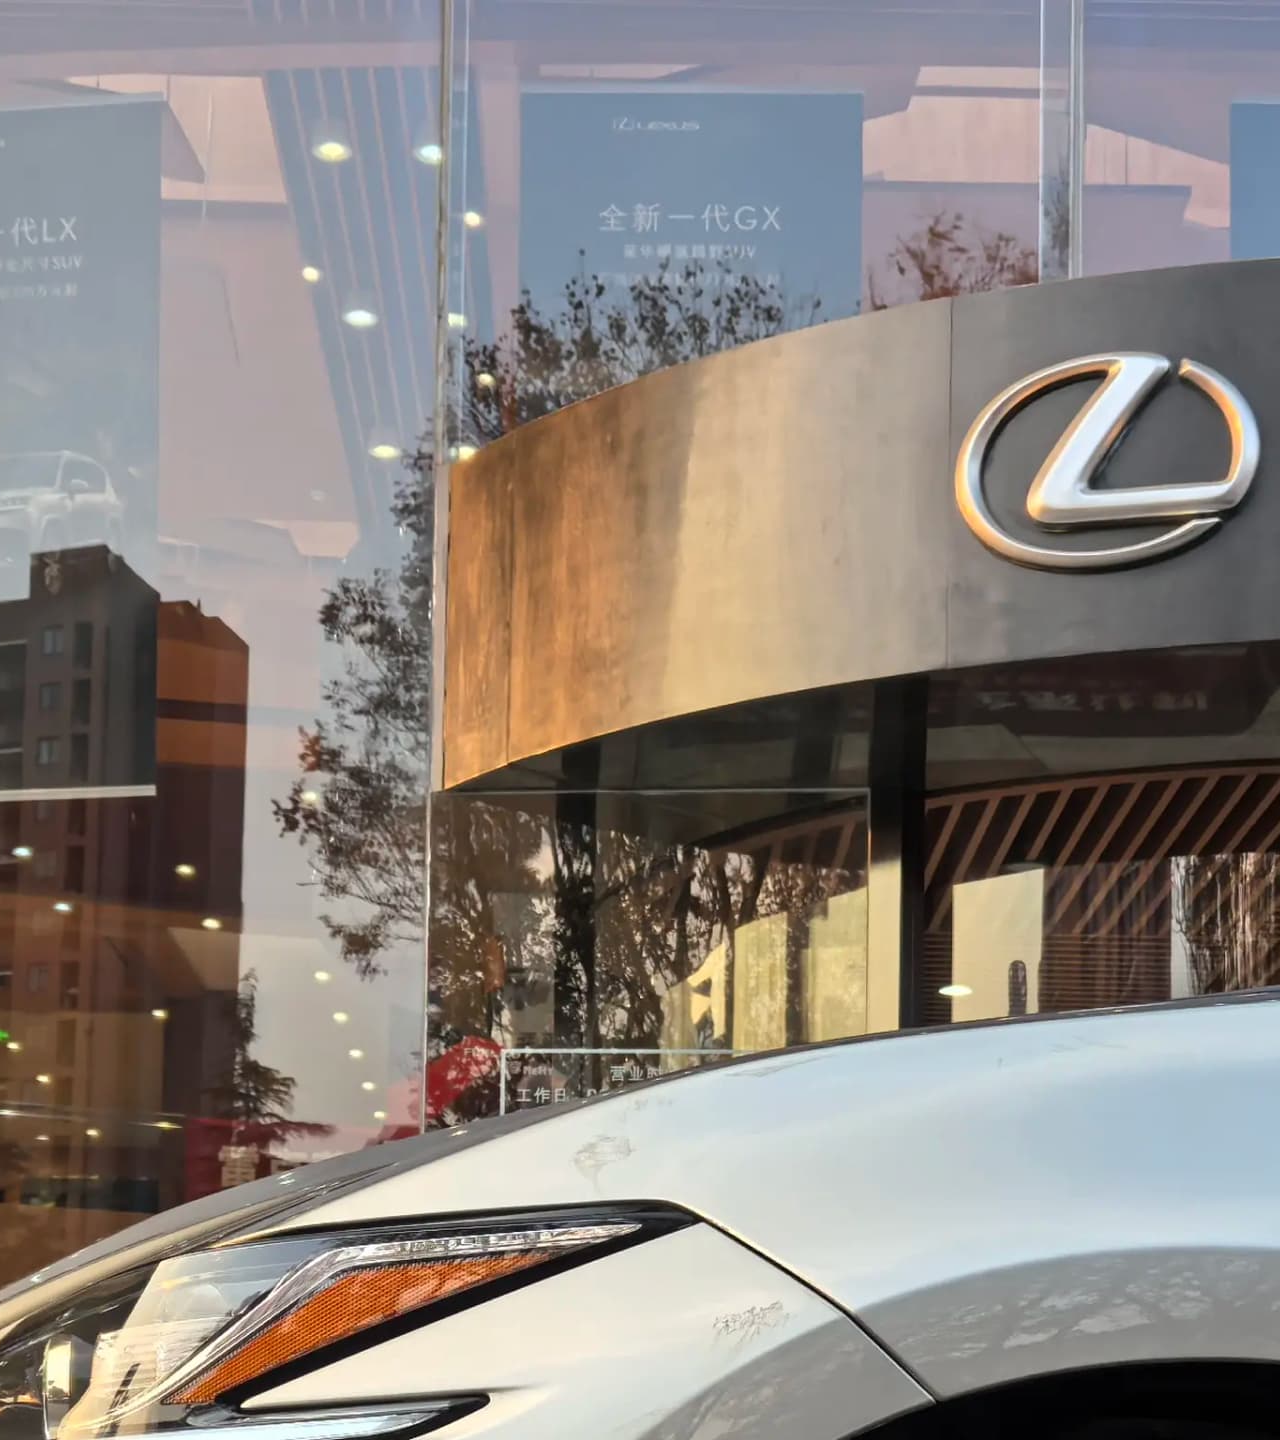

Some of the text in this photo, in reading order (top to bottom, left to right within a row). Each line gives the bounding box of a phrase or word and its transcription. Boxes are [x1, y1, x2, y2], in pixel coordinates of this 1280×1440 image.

[599, 203, 782, 232] 全新一代GX
[610, 1064, 663, 1082] 营业时
